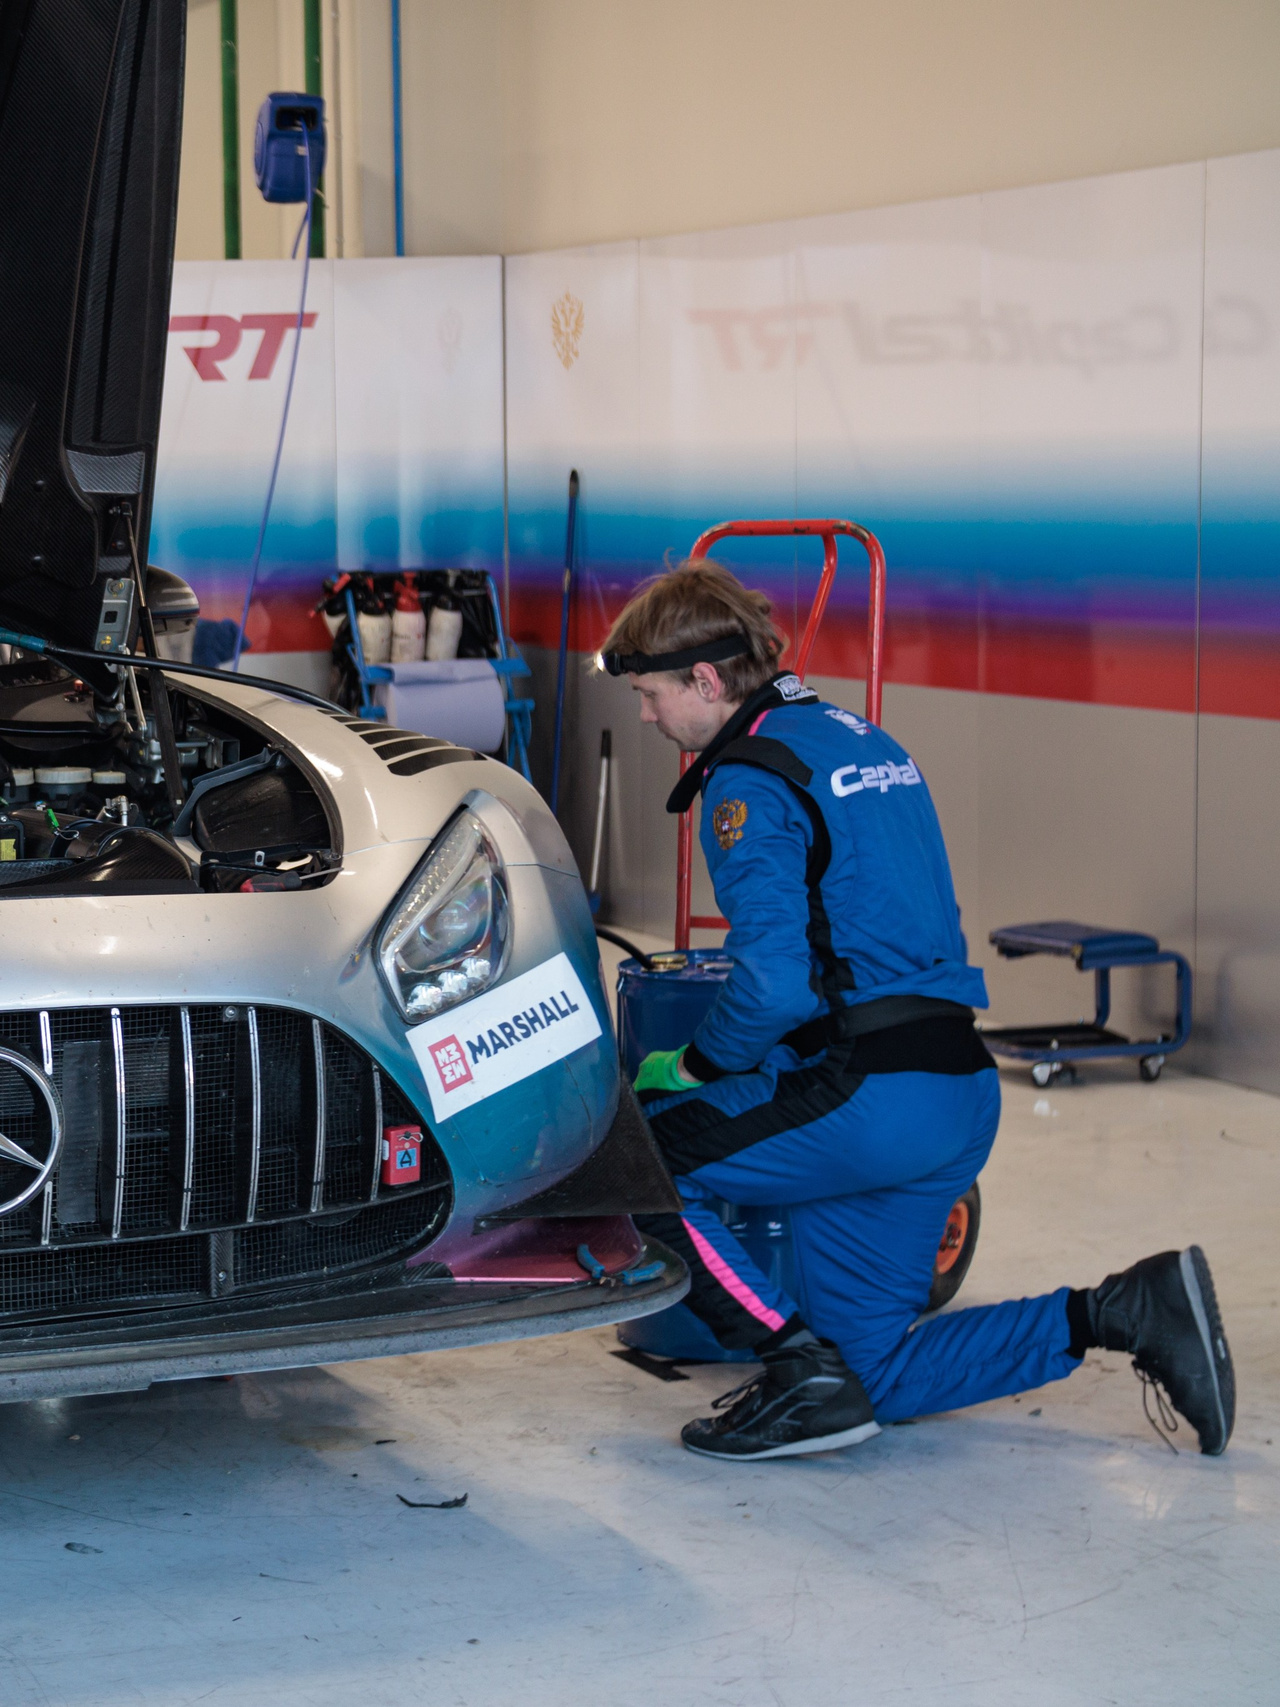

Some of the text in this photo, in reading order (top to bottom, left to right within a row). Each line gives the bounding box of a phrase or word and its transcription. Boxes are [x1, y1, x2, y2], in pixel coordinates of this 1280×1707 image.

[168, 312, 318, 382] RT
[830, 757, 922, 798] Capital
[465, 990, 580, 1065] MARSHALL
[400, 1148, 413, 1168] A
